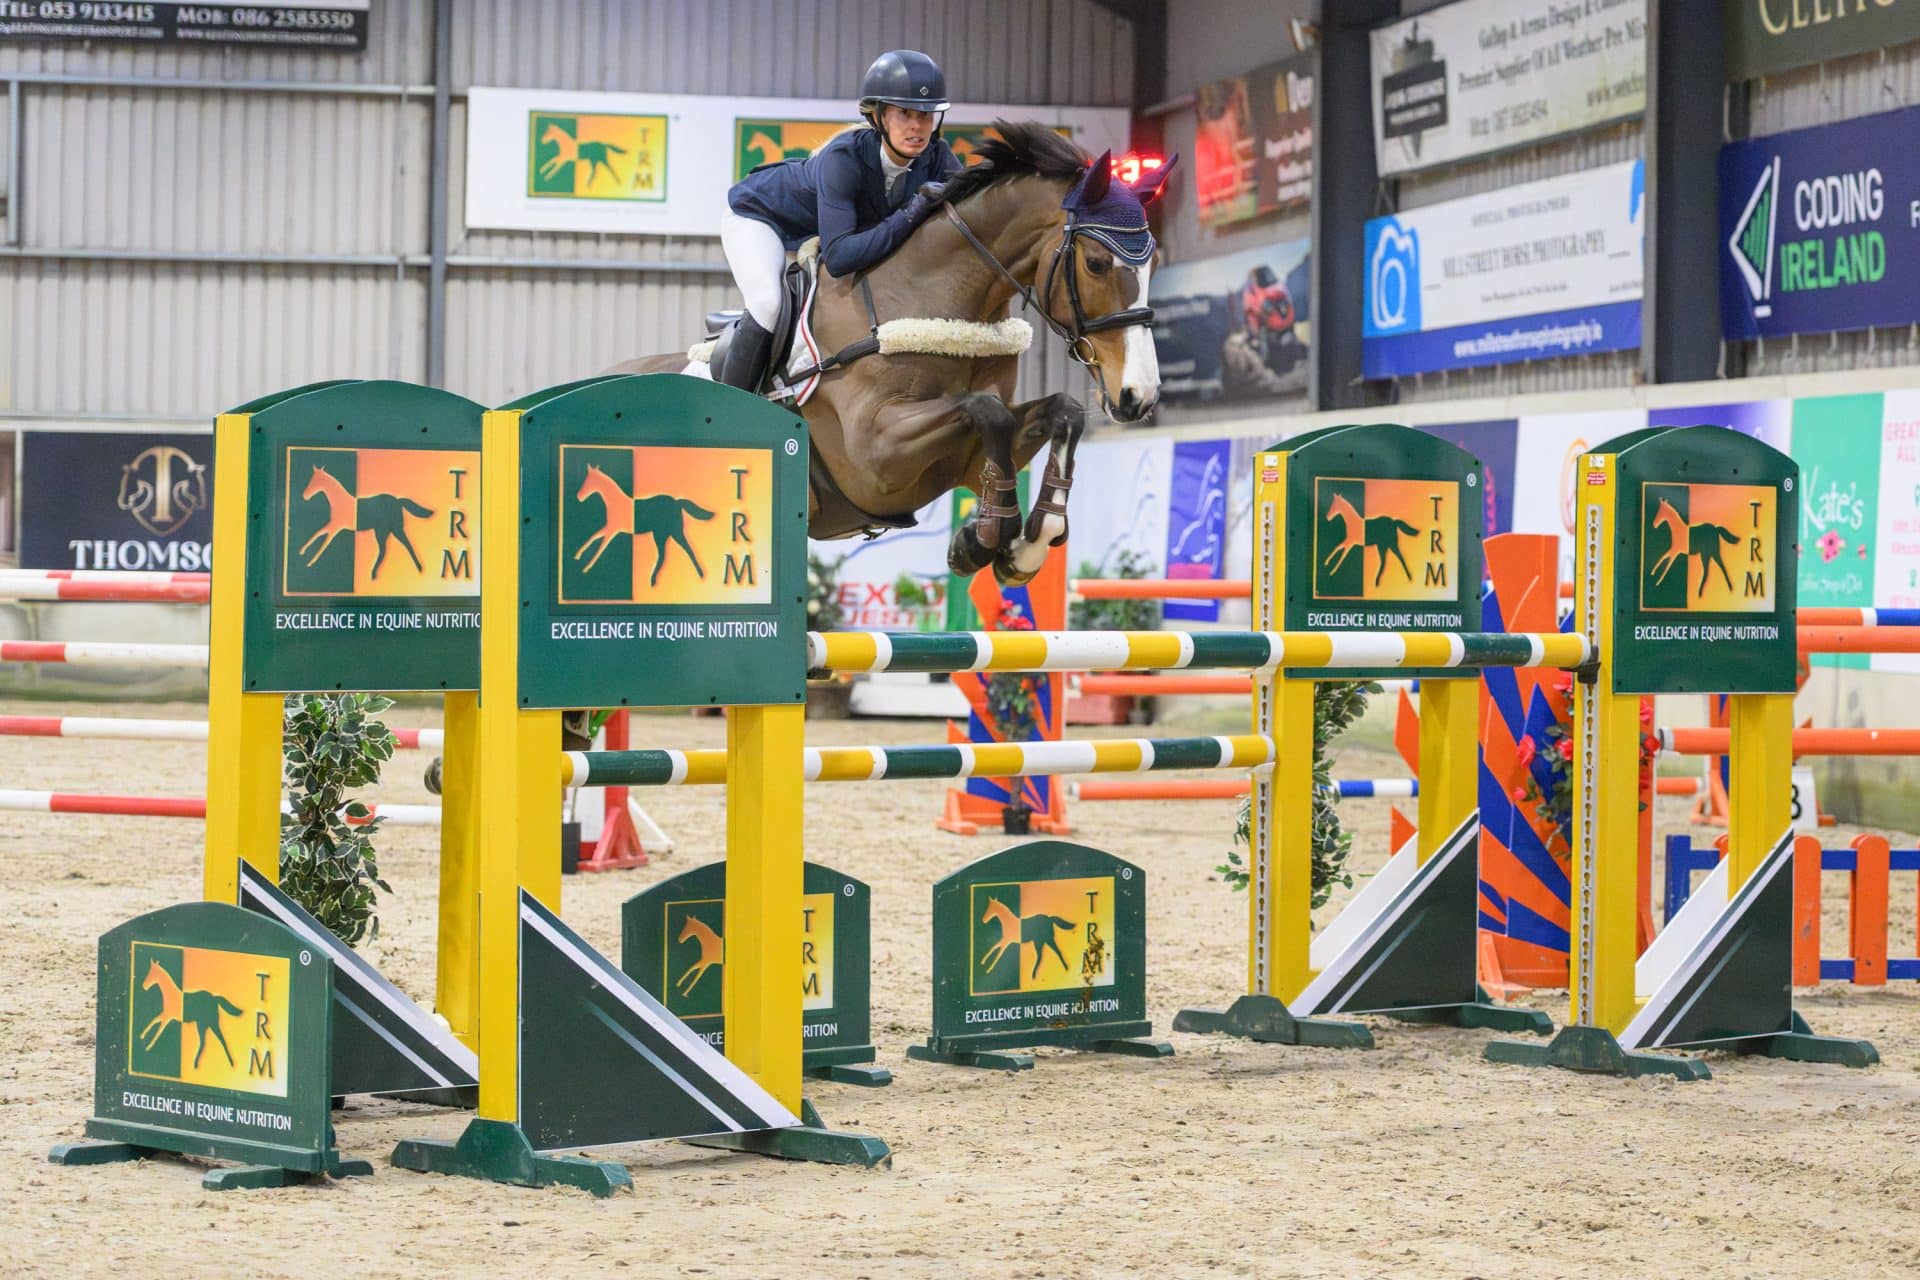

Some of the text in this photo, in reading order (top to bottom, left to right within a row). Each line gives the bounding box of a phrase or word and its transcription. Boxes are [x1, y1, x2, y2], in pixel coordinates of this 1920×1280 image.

[39, 1, 76, 20] 053
[1794, 168, 1884, 232] CODING
[1780, 229, 1886, 293] IRELAND
[441, 469, 472, 579] TRM
[723, 467, 755, 586] TRM
[1801, 464, 1864, 539] Kate's
[1424, 496, 1448, 587] TRM
[1744, 500, 1765, 598] TRM
[276, 612, 481, 631] EXCELLENCE IN EQUINE NUTRITIO
[551, 621, 778, 641] EXCELLENCE IN EQUINE NUTRITION
[1308, 613, 1462, 629] EXCELLENCE IN EQUINE NUTRITION
[1635, 626, 1779, 642] EXCELLENCE IN EQUINE NUTRITION
[248, 972, 274, 1079] TRM
[802, 1023, 838, 1038] RITION
[965, 1007, 1022, 1024] EXCELLENCE
[1024, 1005, 1034, 1018] IN
[1036, 1002, 1069, 1018] EQUINE
[122, 1091, 292, 1131] EXCELLENCE IN EQUINE NUTRITION
